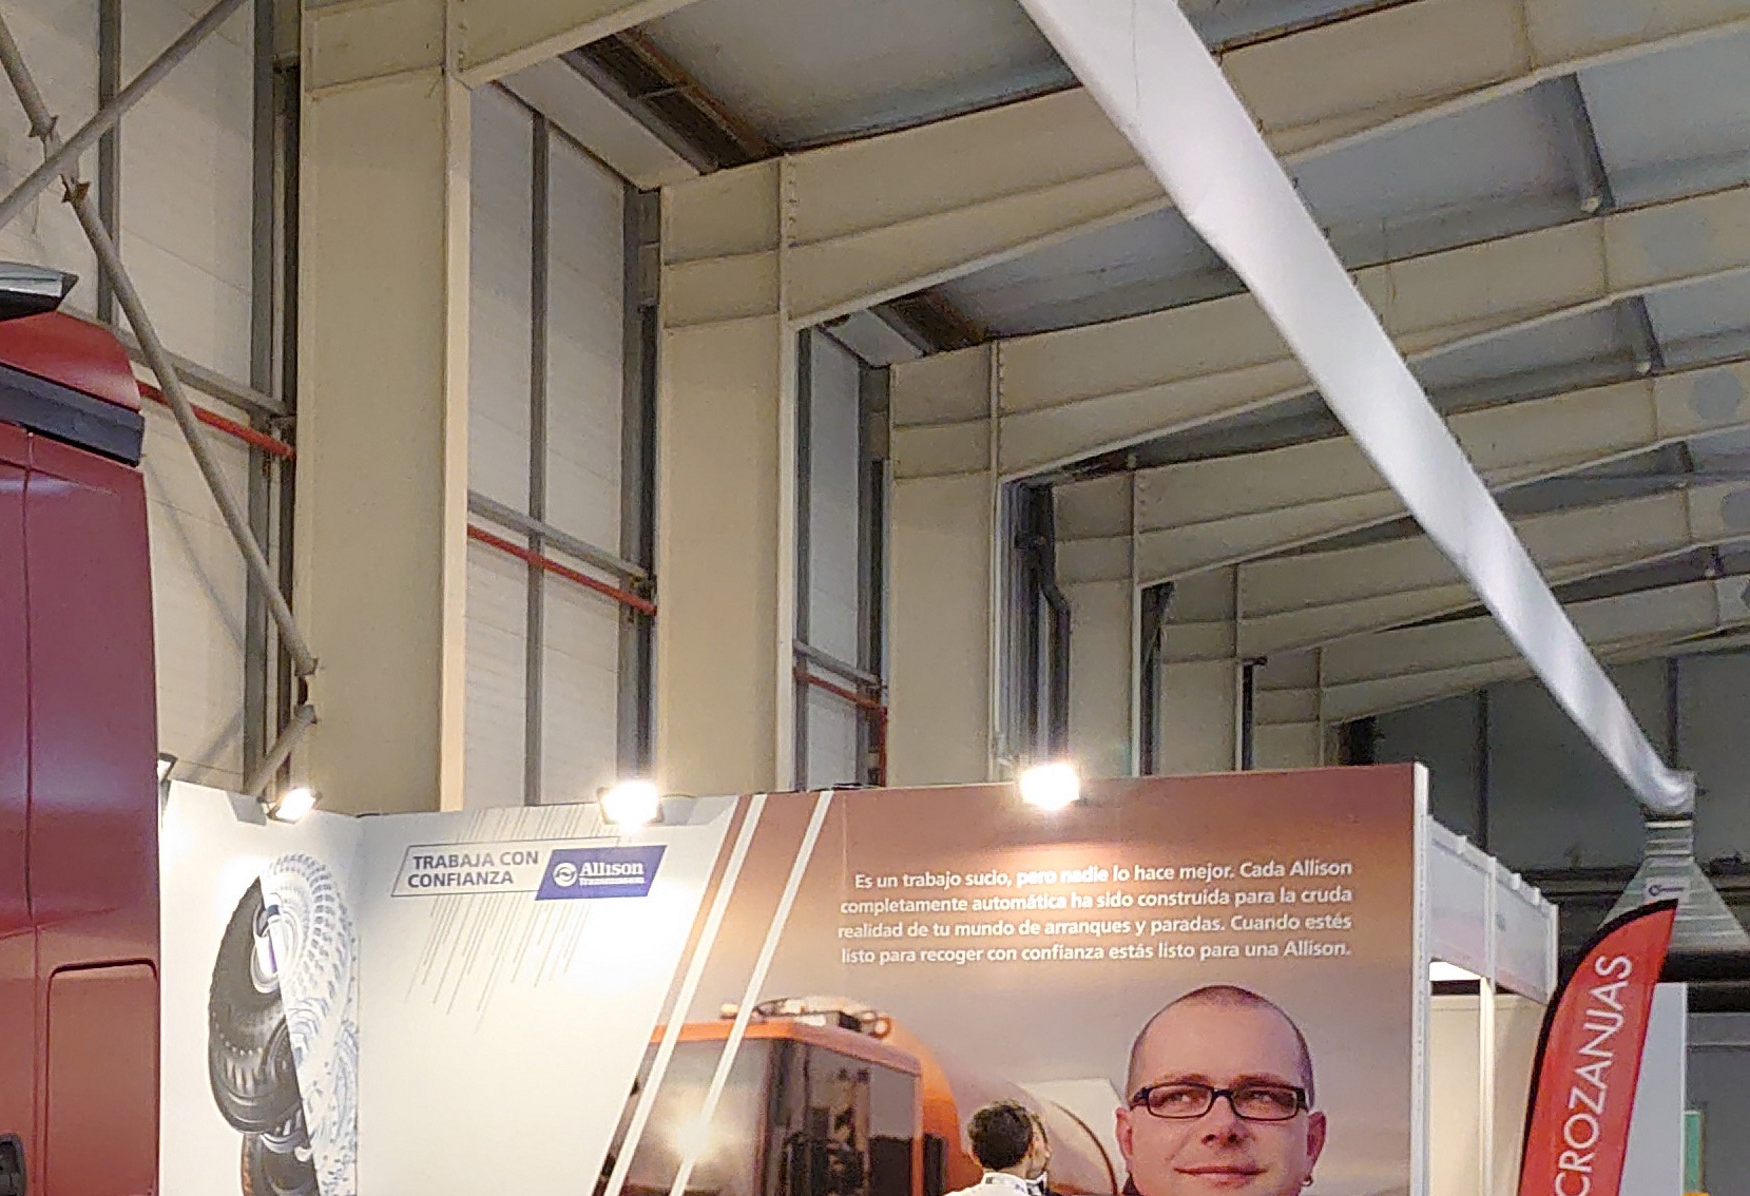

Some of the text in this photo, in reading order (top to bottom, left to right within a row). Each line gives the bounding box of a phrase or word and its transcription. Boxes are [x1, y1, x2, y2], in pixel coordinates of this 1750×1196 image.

[413, 850, 539, 870] TRABAJA CON
[579, 861, 644, 877] Allison
[408, 870, 514, 888] CONFIANZA
[854, 873, 873, 889] Es
[877, 876, 898, 888] un
[903, 870, 961, 890] trabajo
[965, 869, 1013, 888] sucio,
[1017, 870, 1056, 887] pero
[1113, 866, 1130, 882] lo
[1134, 864, 1174, 881] hace
[1180, 863, 1235, 882] mejor.
[1240, 861, 1285, 878] Cada
[1290, 860, 1352, 877] Allison
[840, 886, 1353, 916] completamente automática ha sido construida para la cruda
[838, 912, 1352, 939] realidad de tu mundo de arranques y paradas. Cuando estés
[841, 939, 1350, 966] listo para recoger con confianza estás listo para una Allison.
